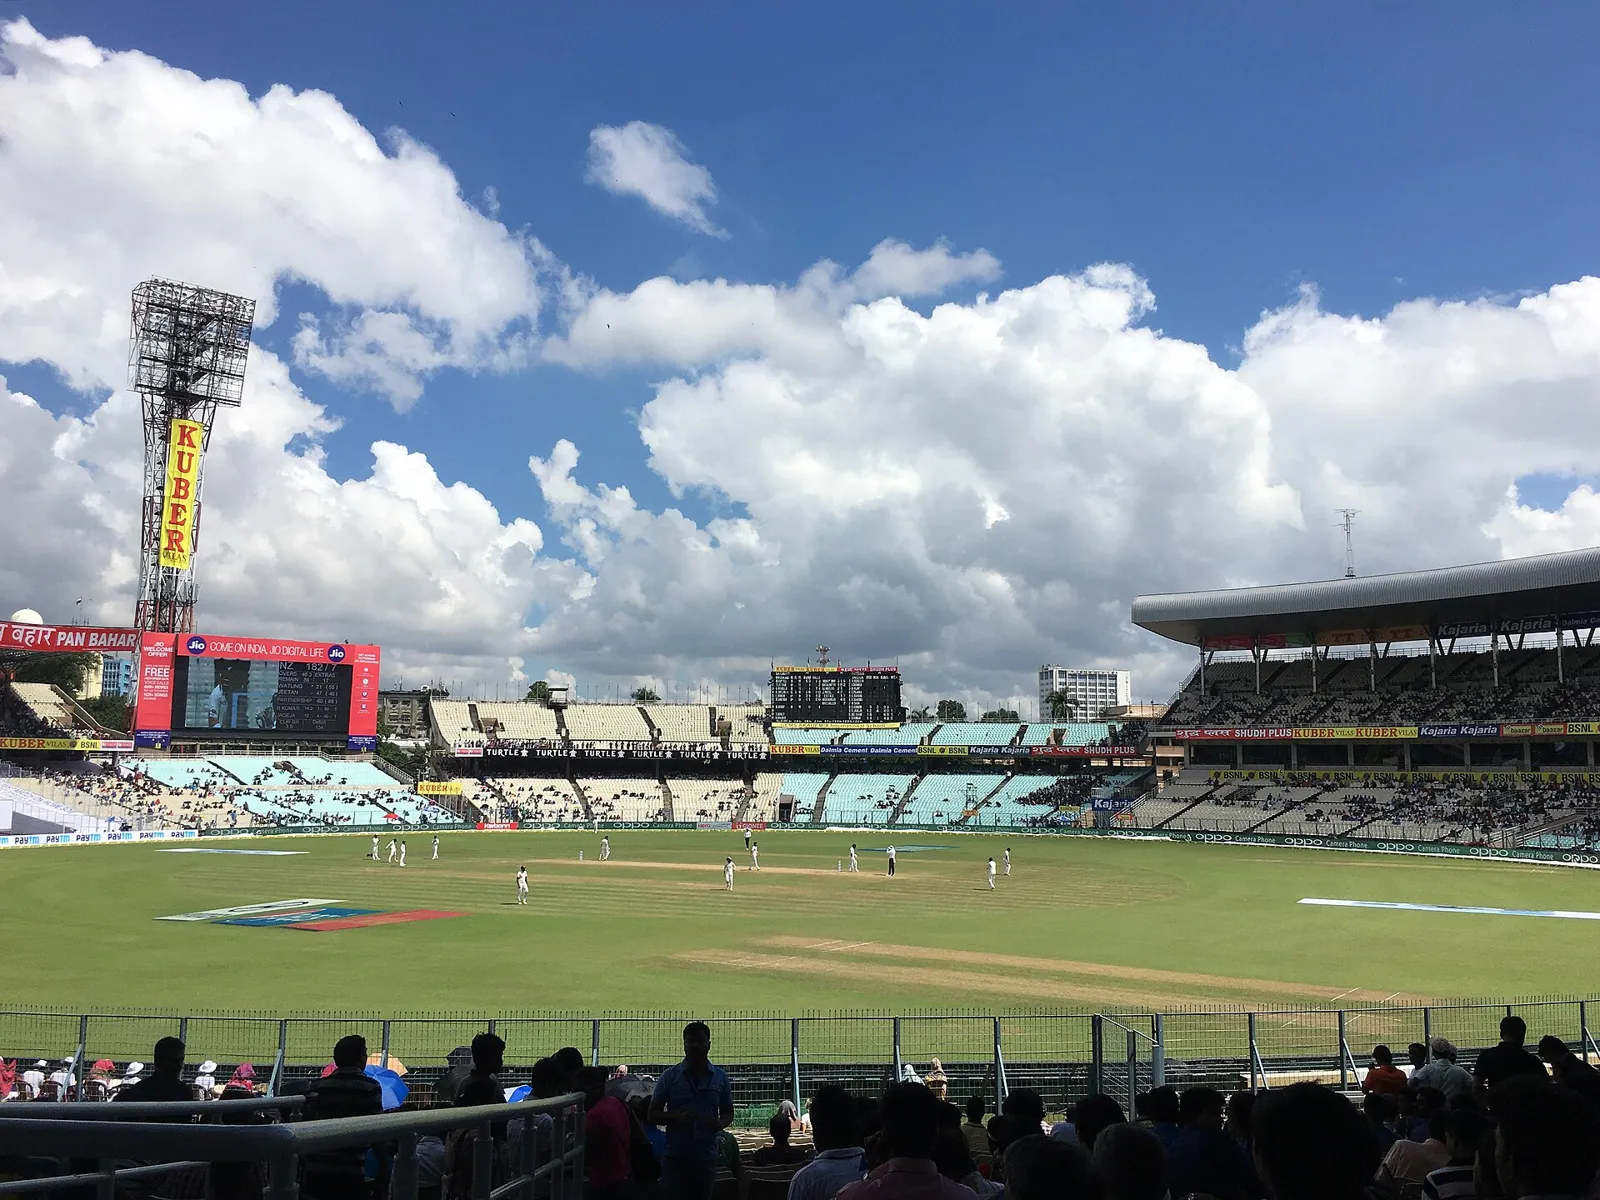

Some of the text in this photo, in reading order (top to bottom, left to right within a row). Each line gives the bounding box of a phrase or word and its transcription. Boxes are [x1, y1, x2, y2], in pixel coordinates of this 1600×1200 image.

[165, 424, 198, 553] KUBER
[1437, 622, 1487, 638] Kajaria
[1500, 619, 1552, 633] Kajaria
[57, 631, 137, 648] PAN BAHAR
[188, 640, 205, 650] Jio
[210, 641, 324, 658] COME ON INDIA, JIO DIGITAL LIFE
[329, 649, 344, 658] Jio
[279, 662, 294, 670] NZ
[144, 667, 170, 677] FREE
[1234, 729, 1292, 737] SHUDH PLUS
[1293, 728, 1335, 737] KUBER
[1355, 728, 1398, 737] KUBER
[1420, 725, 1498, 737] Kajaria Kajaria
[1568, 724, 1594, 733] BSNL
[0, 738, 46, 749] KUBER
[80, 740, 100, 749] BSNL
[487, 748, 519, 758] TURTLE
[535, 749, 569, 759] TURTLE
[584, 749, 617, 759] TURTLE
[632, 750, 664, 759] TURTLE
[771, 745, 805, 754] KUBER
[969, 746, 1030, 755] Kajaria Kajaria
[679, 751, 711, 760] TURTLE
[727, 751, 759, 760] TURTLE
[1223, 771, 1245, 779] BSNL
[1373, 773, 1396, 781] BSNL
[1453, 774, 1477, 782] BSNL
[1493, 774, 1517, 782] BSNL
[1520, 774, 1545, 782] BSNL
[419, 784, 448, 792] KUBER
[1169, 832, 1186, 840] Phone
[1257, 836, 1276, 844] Phone
[1325, 839, 1349, 847] Camera
[1349, 841, 1369, 849] Phone
[1417, 844, 1441, 852] Camera
[1441, 846, 1461, 854] Phone
[1511, 850, 1535, 858] Camera
[1535, 851, 1554, 860] Phone
